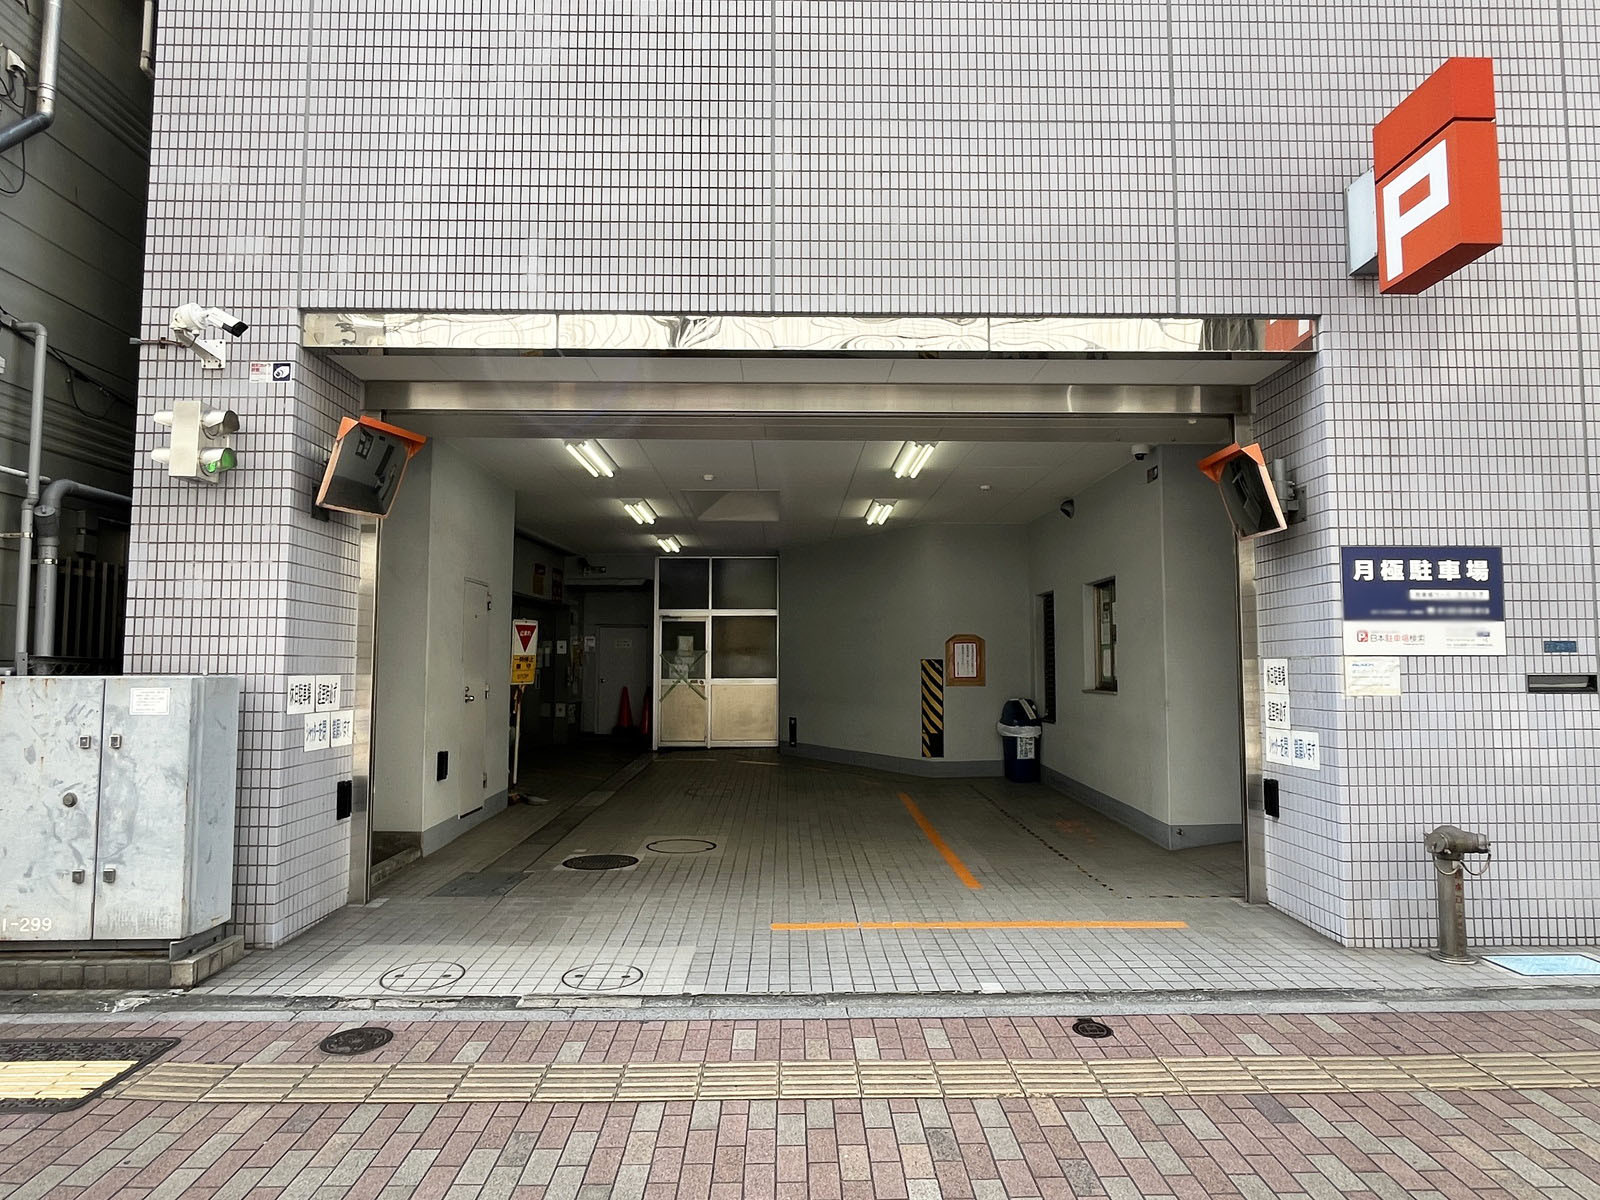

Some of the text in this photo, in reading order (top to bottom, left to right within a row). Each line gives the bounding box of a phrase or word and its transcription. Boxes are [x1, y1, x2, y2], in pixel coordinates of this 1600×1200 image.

[1382, 139, 1450, 282] P
[1353, 559, 1490, 582] 月極駐車場
